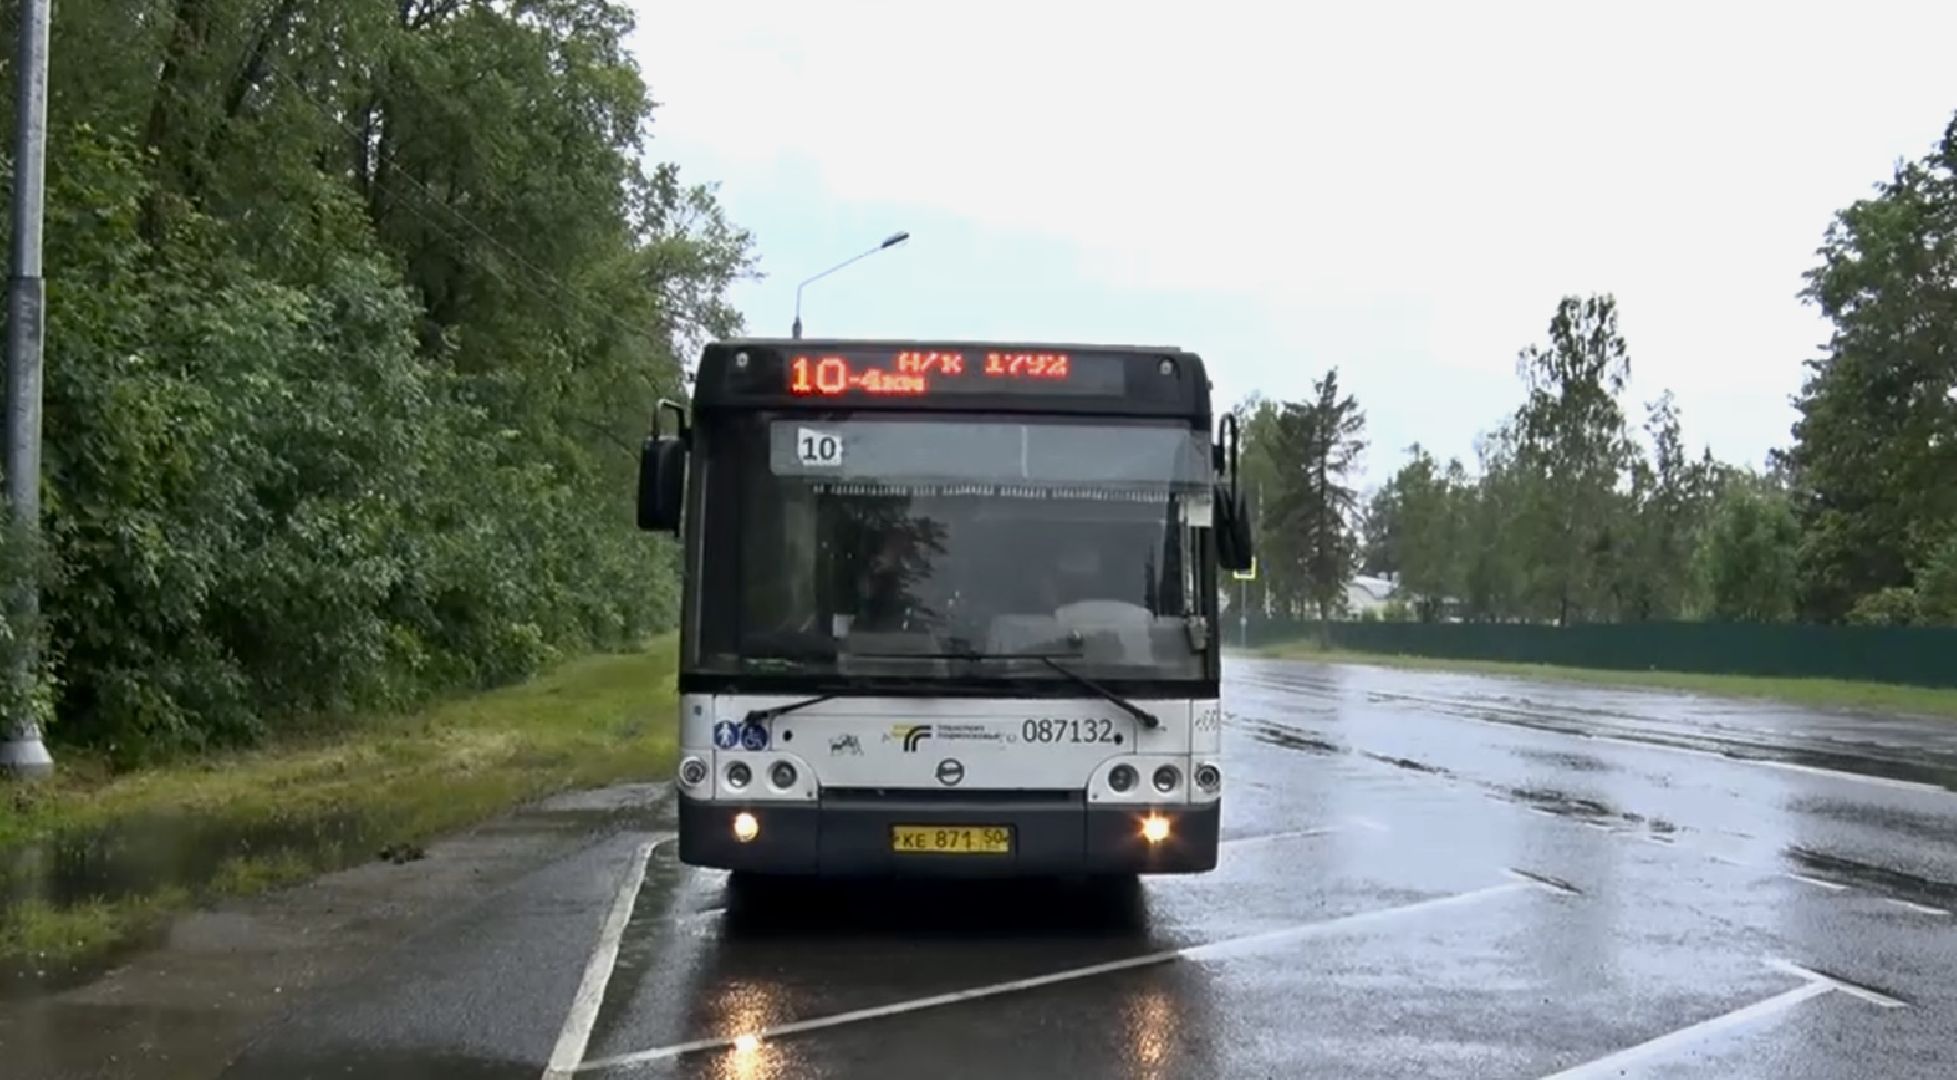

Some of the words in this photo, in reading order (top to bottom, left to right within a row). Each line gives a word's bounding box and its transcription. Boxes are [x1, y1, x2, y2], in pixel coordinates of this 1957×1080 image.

[984, 353, 1068, 376] 1792
[802, 436, 837, 461] 10
[1022, 719, 1113, 743] 087132
[934, 830, 972, 849] 871
[983, 829, 1005, 844] 50
